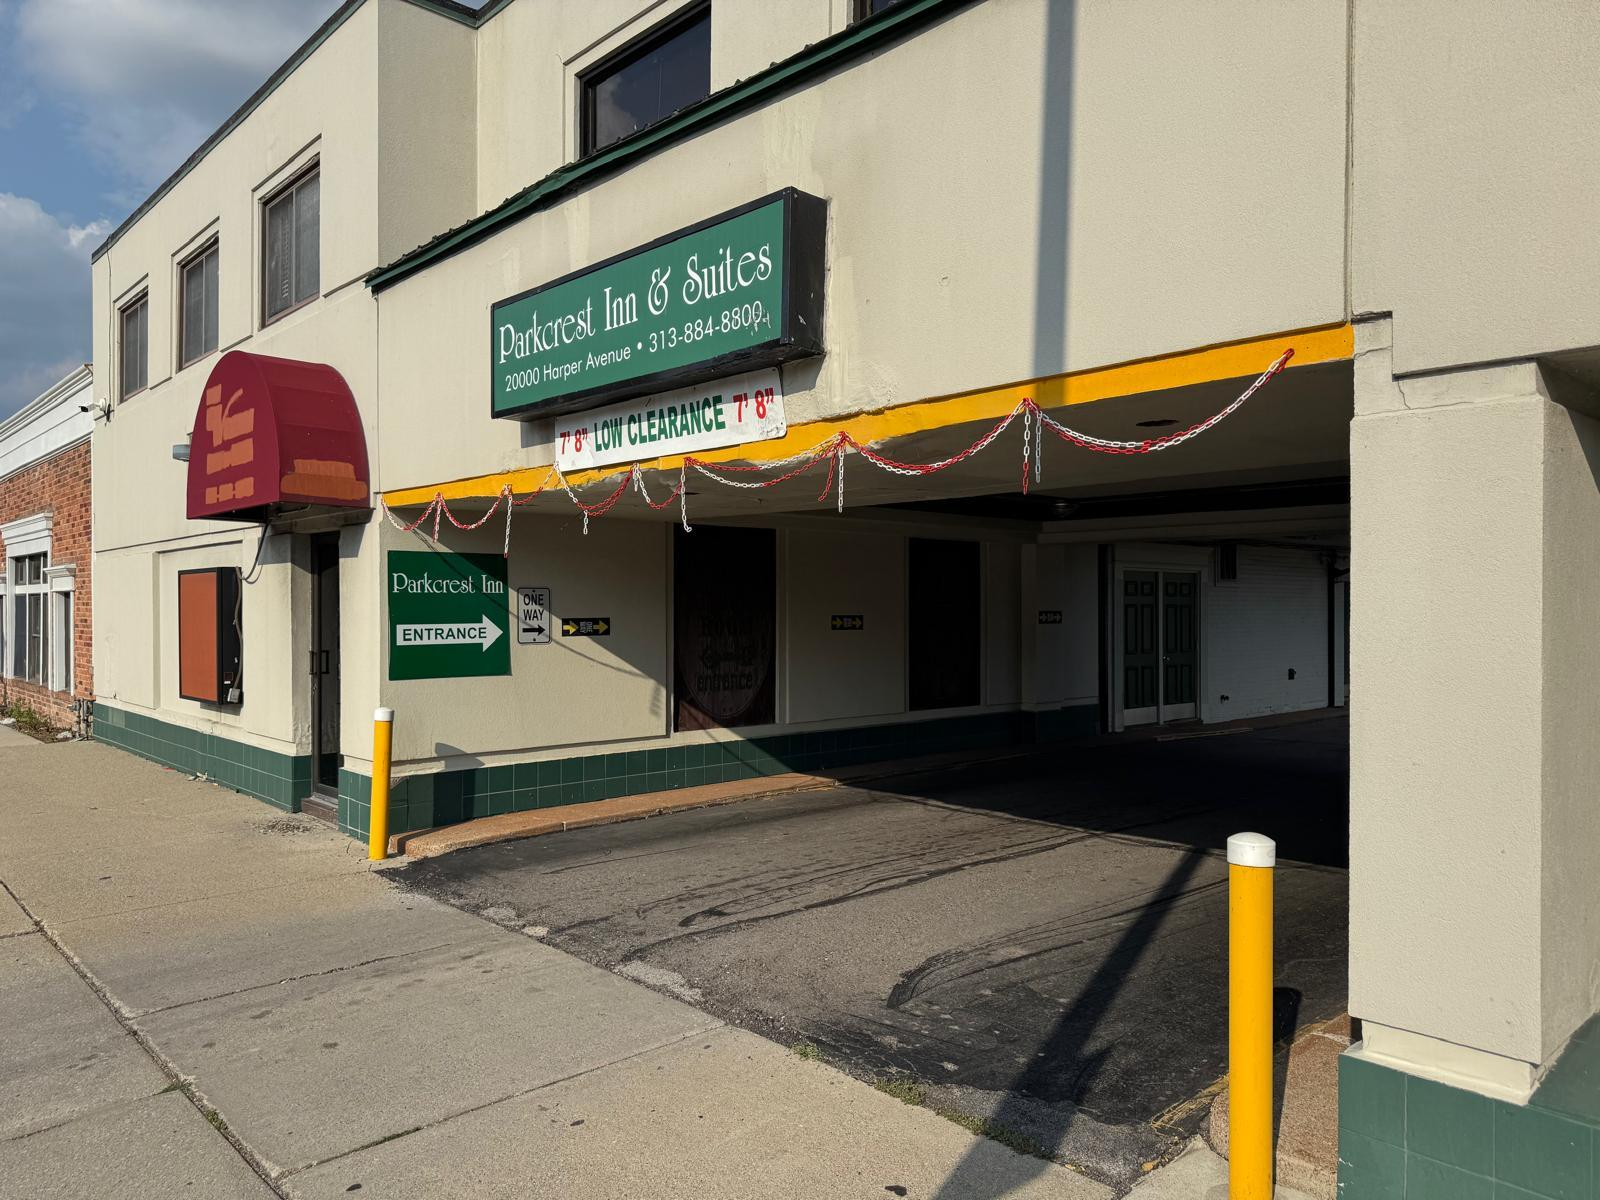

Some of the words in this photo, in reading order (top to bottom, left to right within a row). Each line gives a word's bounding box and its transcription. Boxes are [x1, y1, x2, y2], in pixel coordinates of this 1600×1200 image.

[498, 296, 596, 364] Parkcrest
[603, 286, 638, 332] Inn
[647, 265, 672, 316] &
[682, 243, 772, 305] Suites
[505, 367, 540, 392] 20000
[543, 356, 583, 382] Harper
[585, 345, 632, 370] Avenue
[648, 300, 762, 353] 313-884-8800
[593, 416, 623, 452] LOW
[627, 395, 726, 446] CLEARANCE
[392, 572, 475, 594] Parkcrest
[481, 574, 504, 594] Inn
[523, 593, 545, 606] ONE
[523, 609, 545, 621] WAY
[402, 627, 487, 642] ENTRANCE
